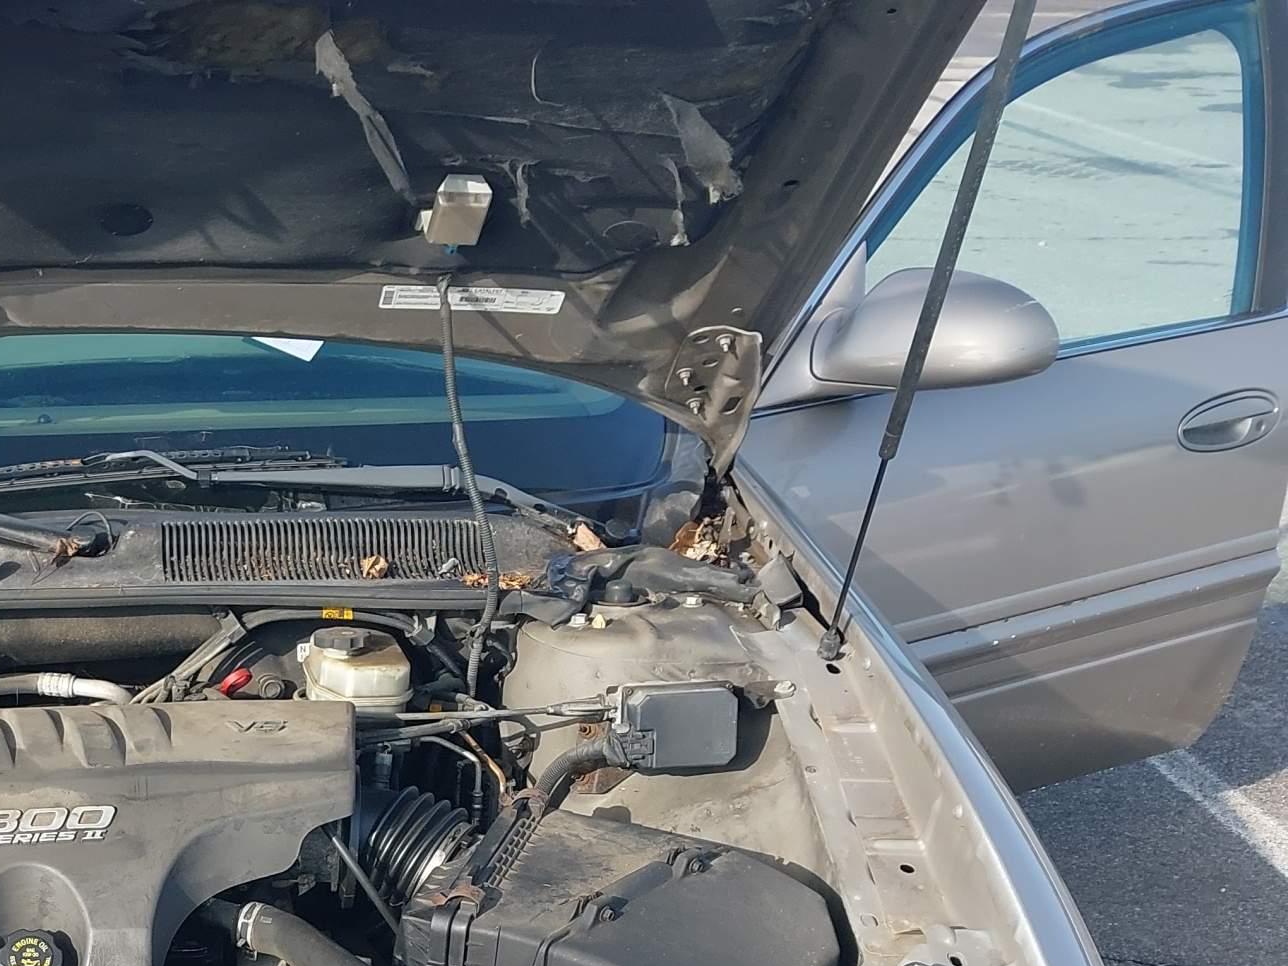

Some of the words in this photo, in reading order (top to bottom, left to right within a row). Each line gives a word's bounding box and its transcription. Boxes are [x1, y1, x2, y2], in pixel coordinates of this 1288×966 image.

[82, 829, 108, 841] II
[12, 938, 39, 951] ENGINE
[39, 942, 48, 952] OIL
